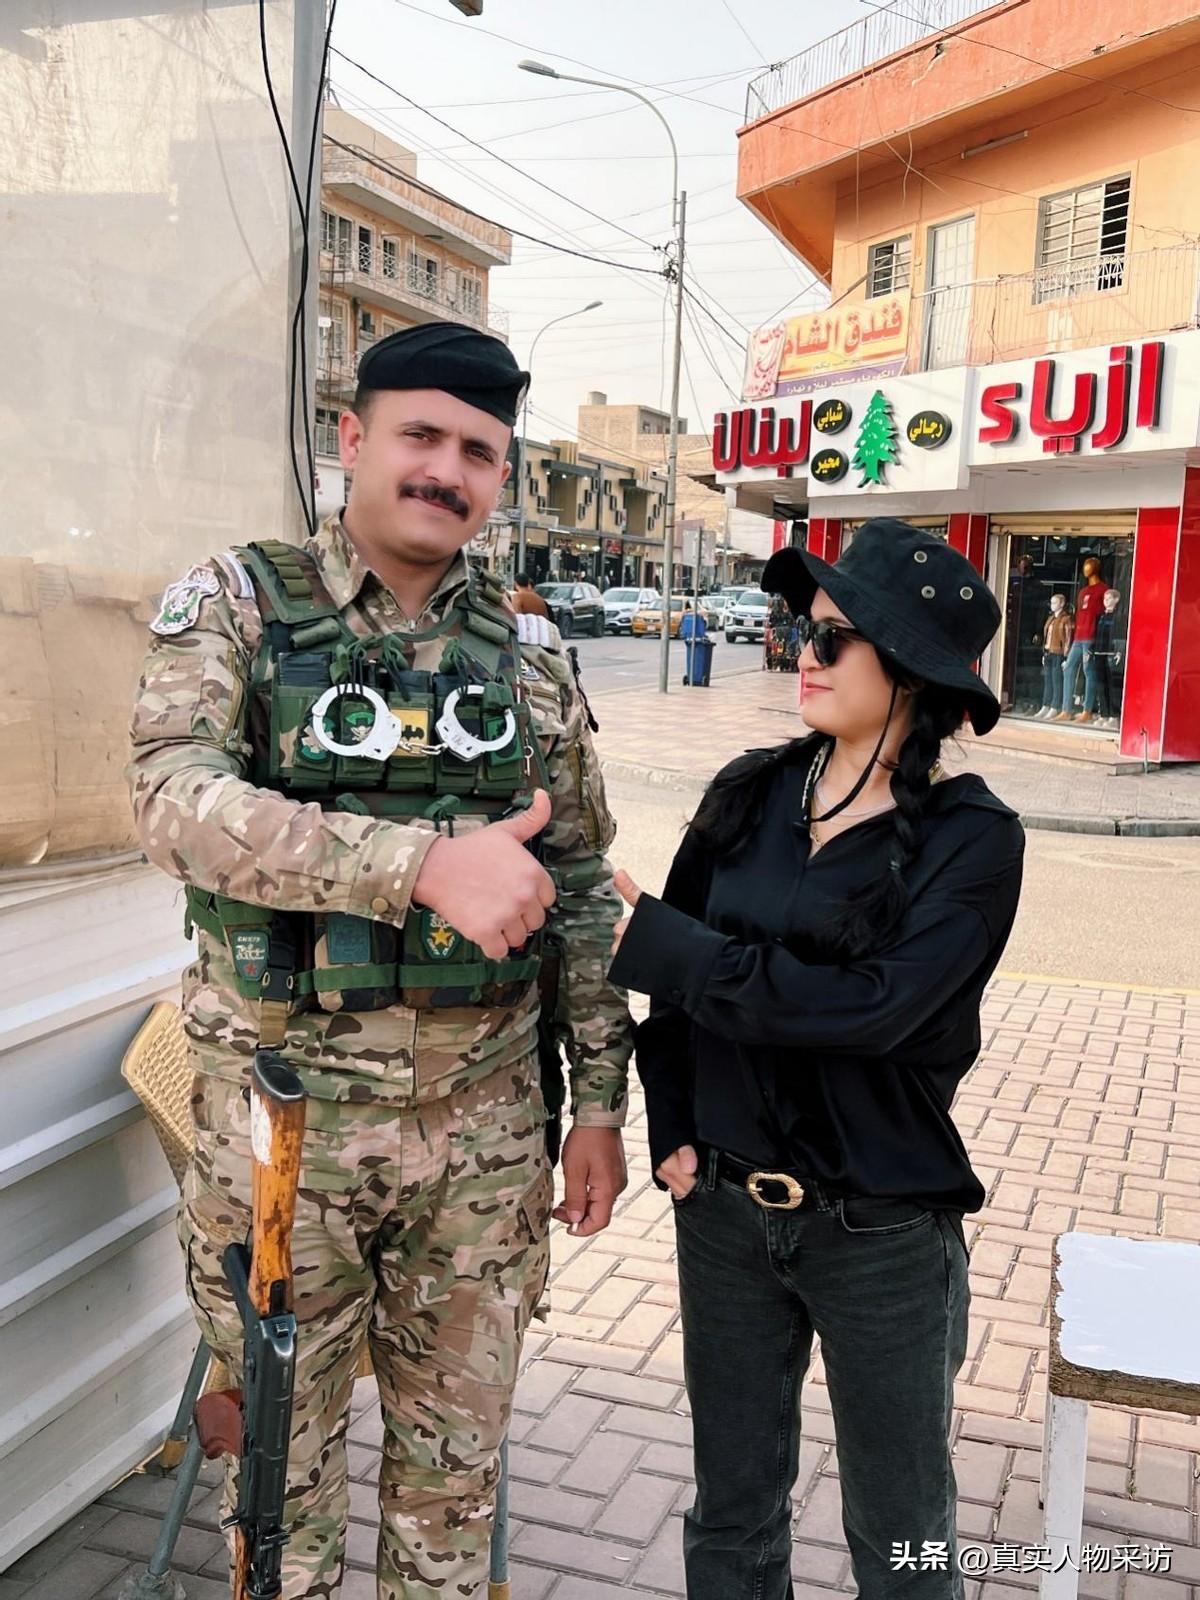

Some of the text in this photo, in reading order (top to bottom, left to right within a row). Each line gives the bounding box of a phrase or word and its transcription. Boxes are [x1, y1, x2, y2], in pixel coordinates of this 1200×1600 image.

[783, 302, 903, 356] فندق الشام
[713, 341, 1165, 478] ازياء لبنان
[817, 402, 843, 430] شبابي
[909, 418, 943, 441] رجالي
